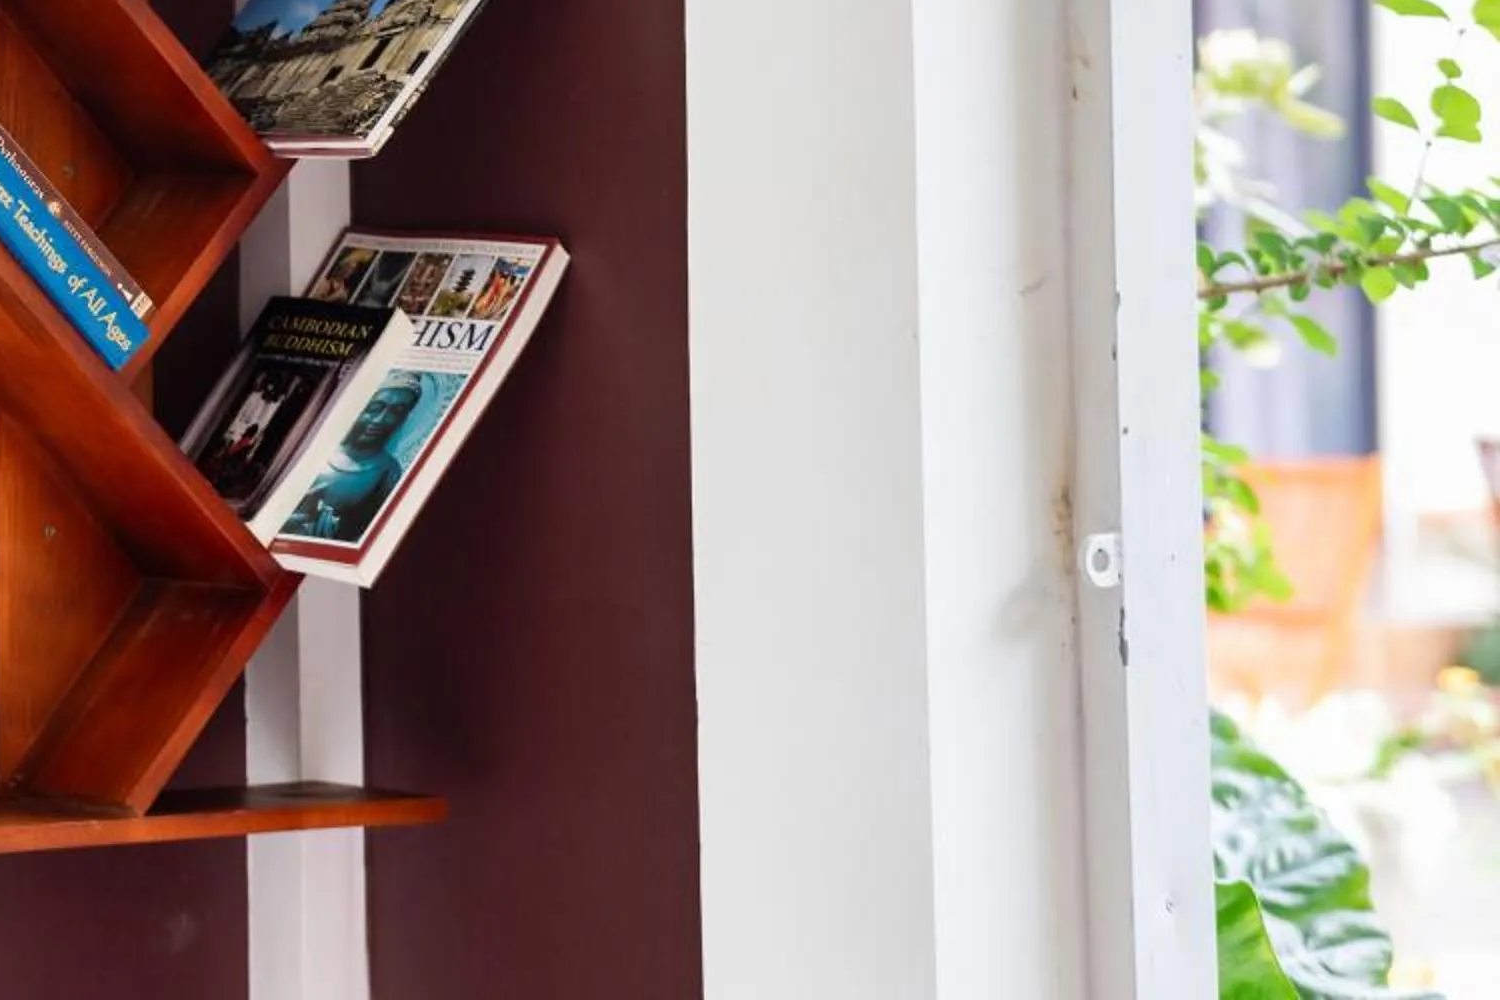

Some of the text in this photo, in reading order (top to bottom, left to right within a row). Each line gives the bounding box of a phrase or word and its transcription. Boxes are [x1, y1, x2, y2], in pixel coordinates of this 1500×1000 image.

[13, 199, 69, 275] Teachings
[67, 274, 89, 295] of
[78, 287, 108, 317] All
[97, 311, 132, 352] Ages
[268, 315, 373, 338] CAMBODIAN
